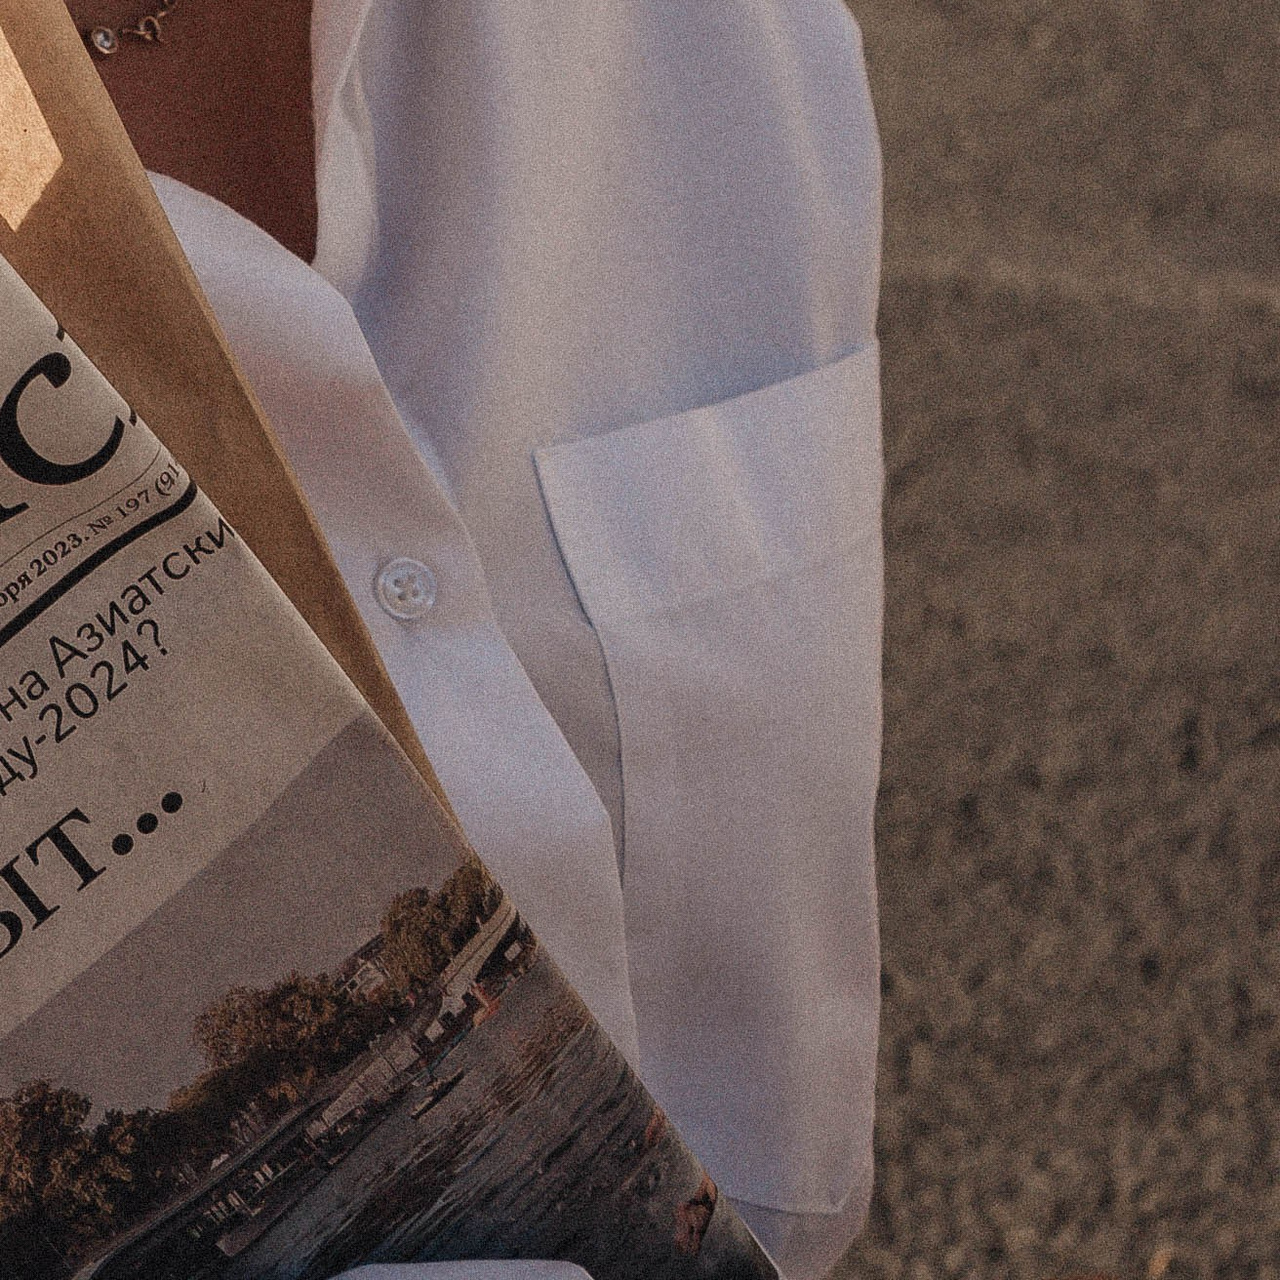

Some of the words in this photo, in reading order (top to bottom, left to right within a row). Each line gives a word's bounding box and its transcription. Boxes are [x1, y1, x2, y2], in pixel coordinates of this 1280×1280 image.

[28, 532, 90, 578] 2023.
[88, 514, 115, 537] №
[115, 489, 151, 521] 197
[155, 461, 185, 497] (91
